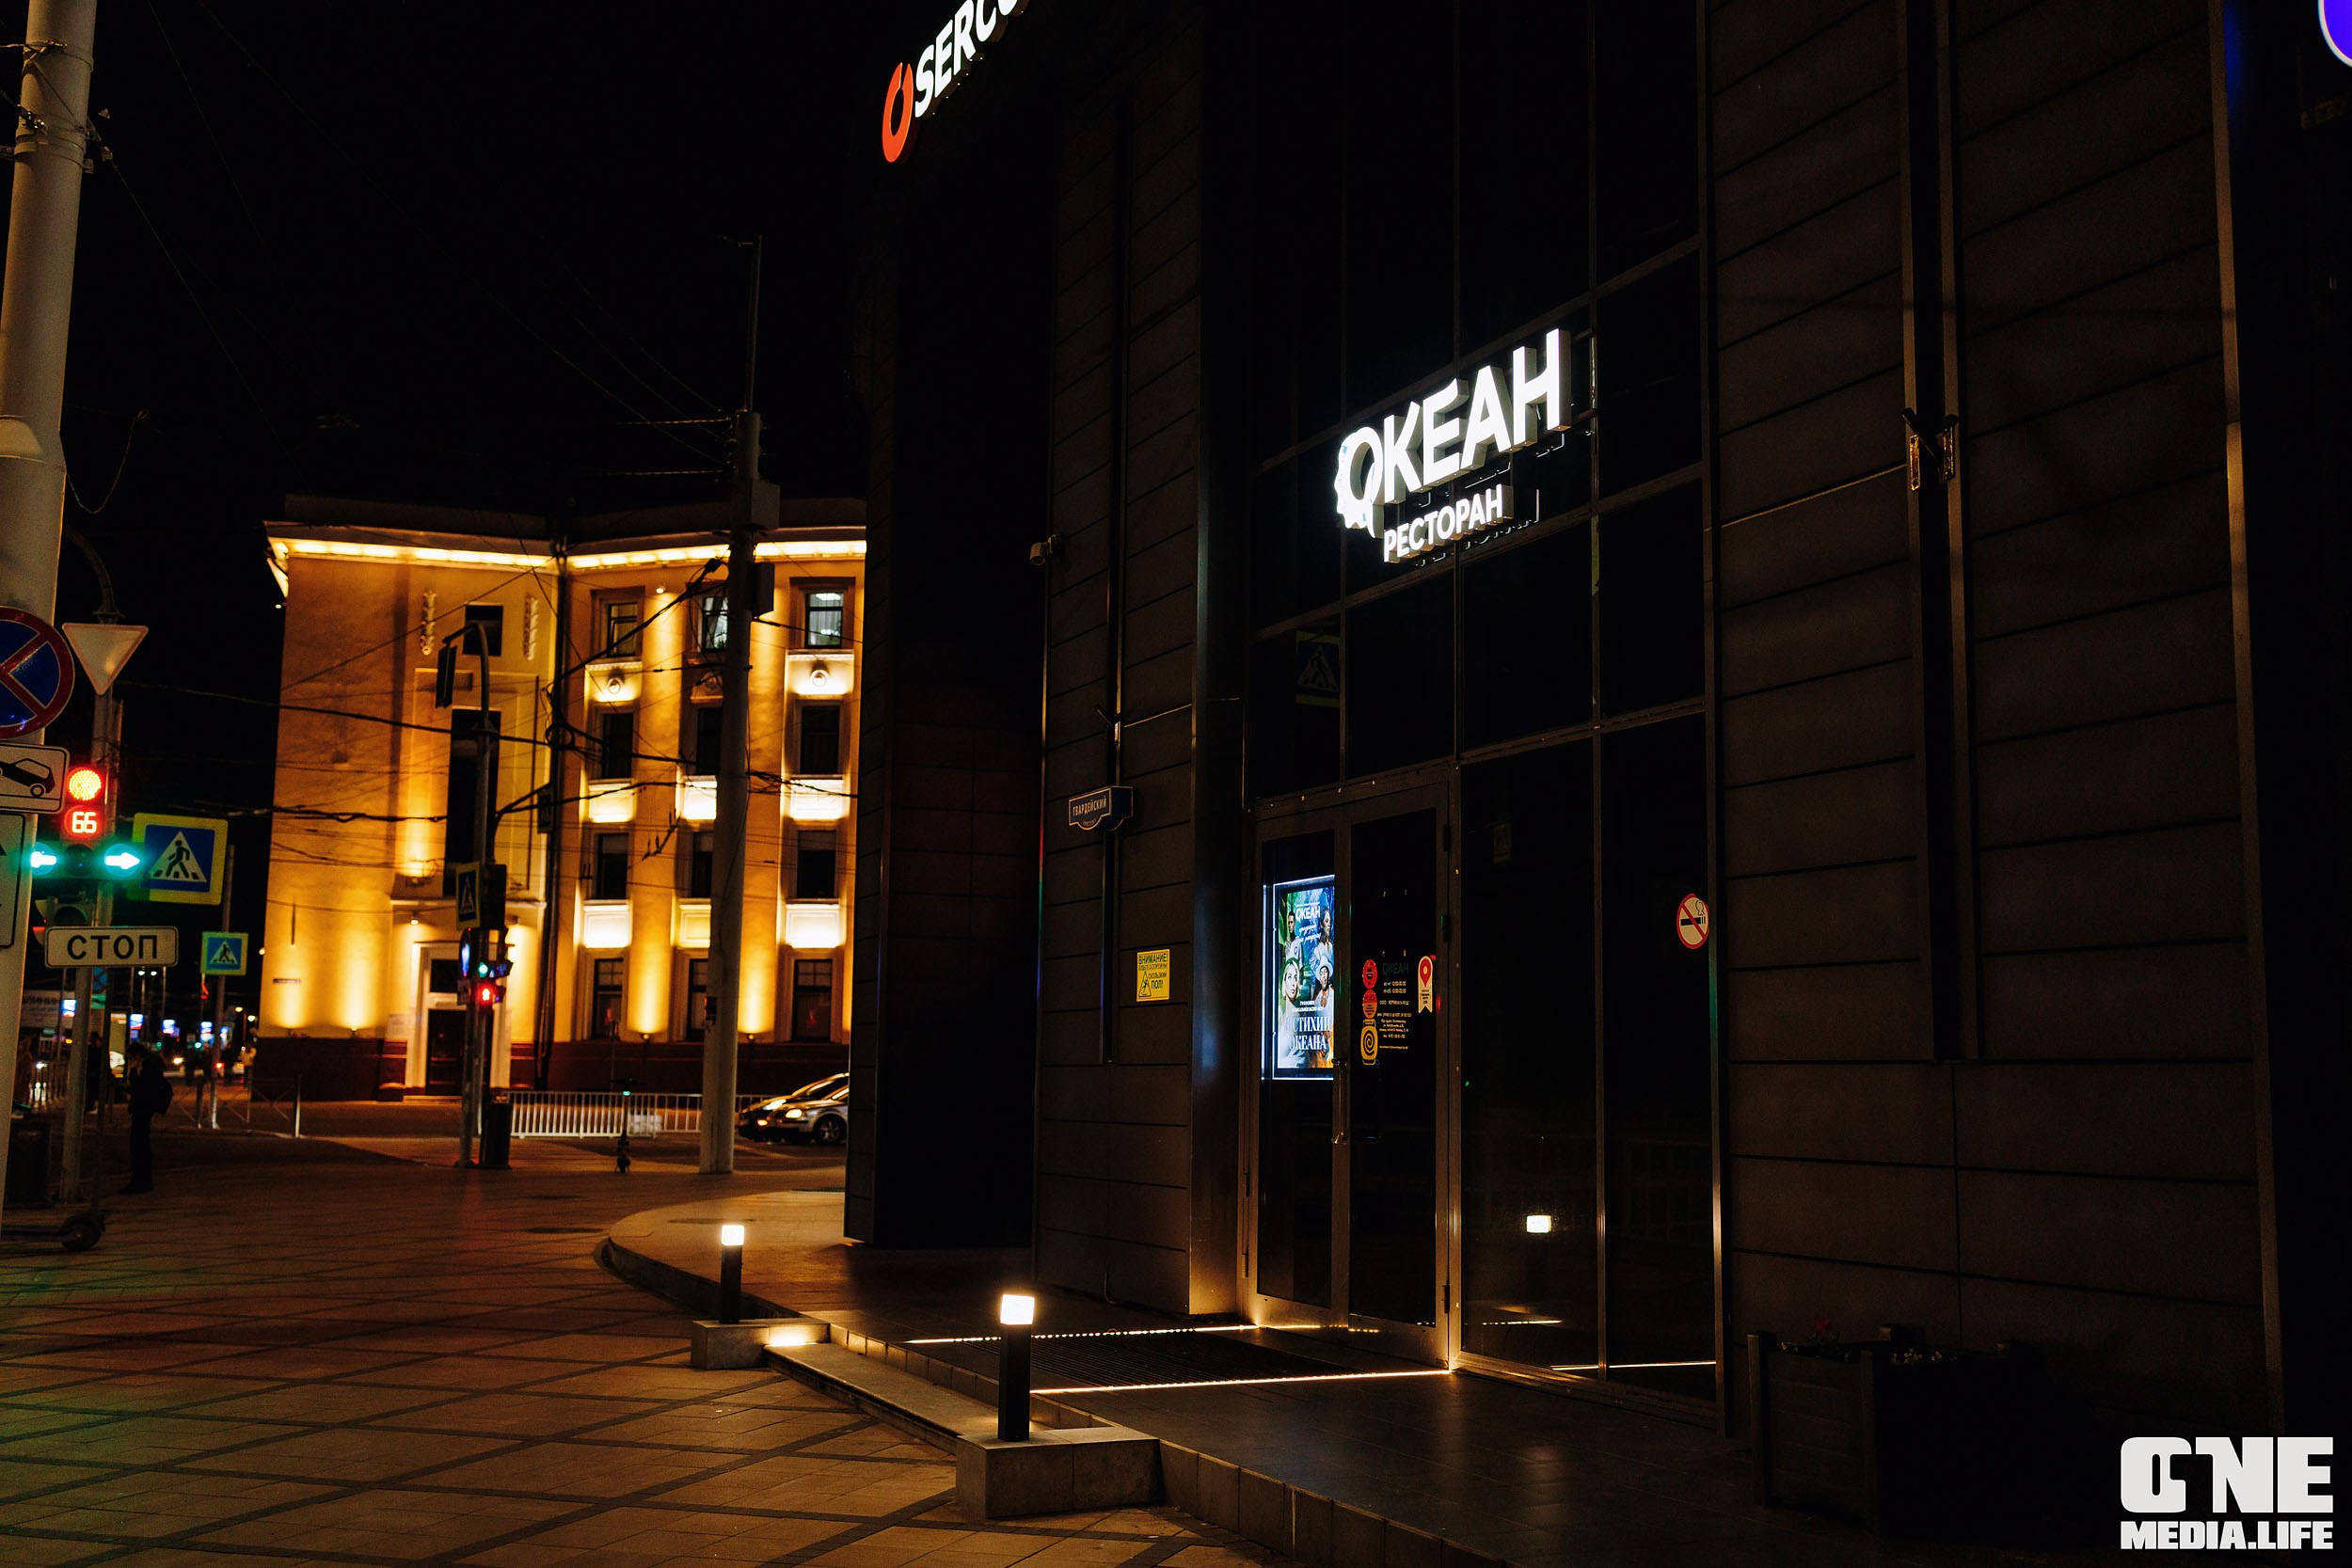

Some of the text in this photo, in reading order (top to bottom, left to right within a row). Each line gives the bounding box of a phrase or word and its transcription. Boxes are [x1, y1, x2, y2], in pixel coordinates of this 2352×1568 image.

[914, 0, 1019, 118] SERC
[1334, 328, 1561, 538] ОКЕАН
[1384, 483, 1504, 562] РЕСТОРАН
[1073, 795, 1107, 816] ГВАРДЕЙСКИЙ
[72, 811, 97, 833] 66
[1295, 905, 1321, 922] ОКЕАН
[67, 934, 158, 959] СТОП
[1138, 953, 1167, 965] ВНИМАНИЕ
[1289, 1035, 1327, 1051] ОКЕАНА
